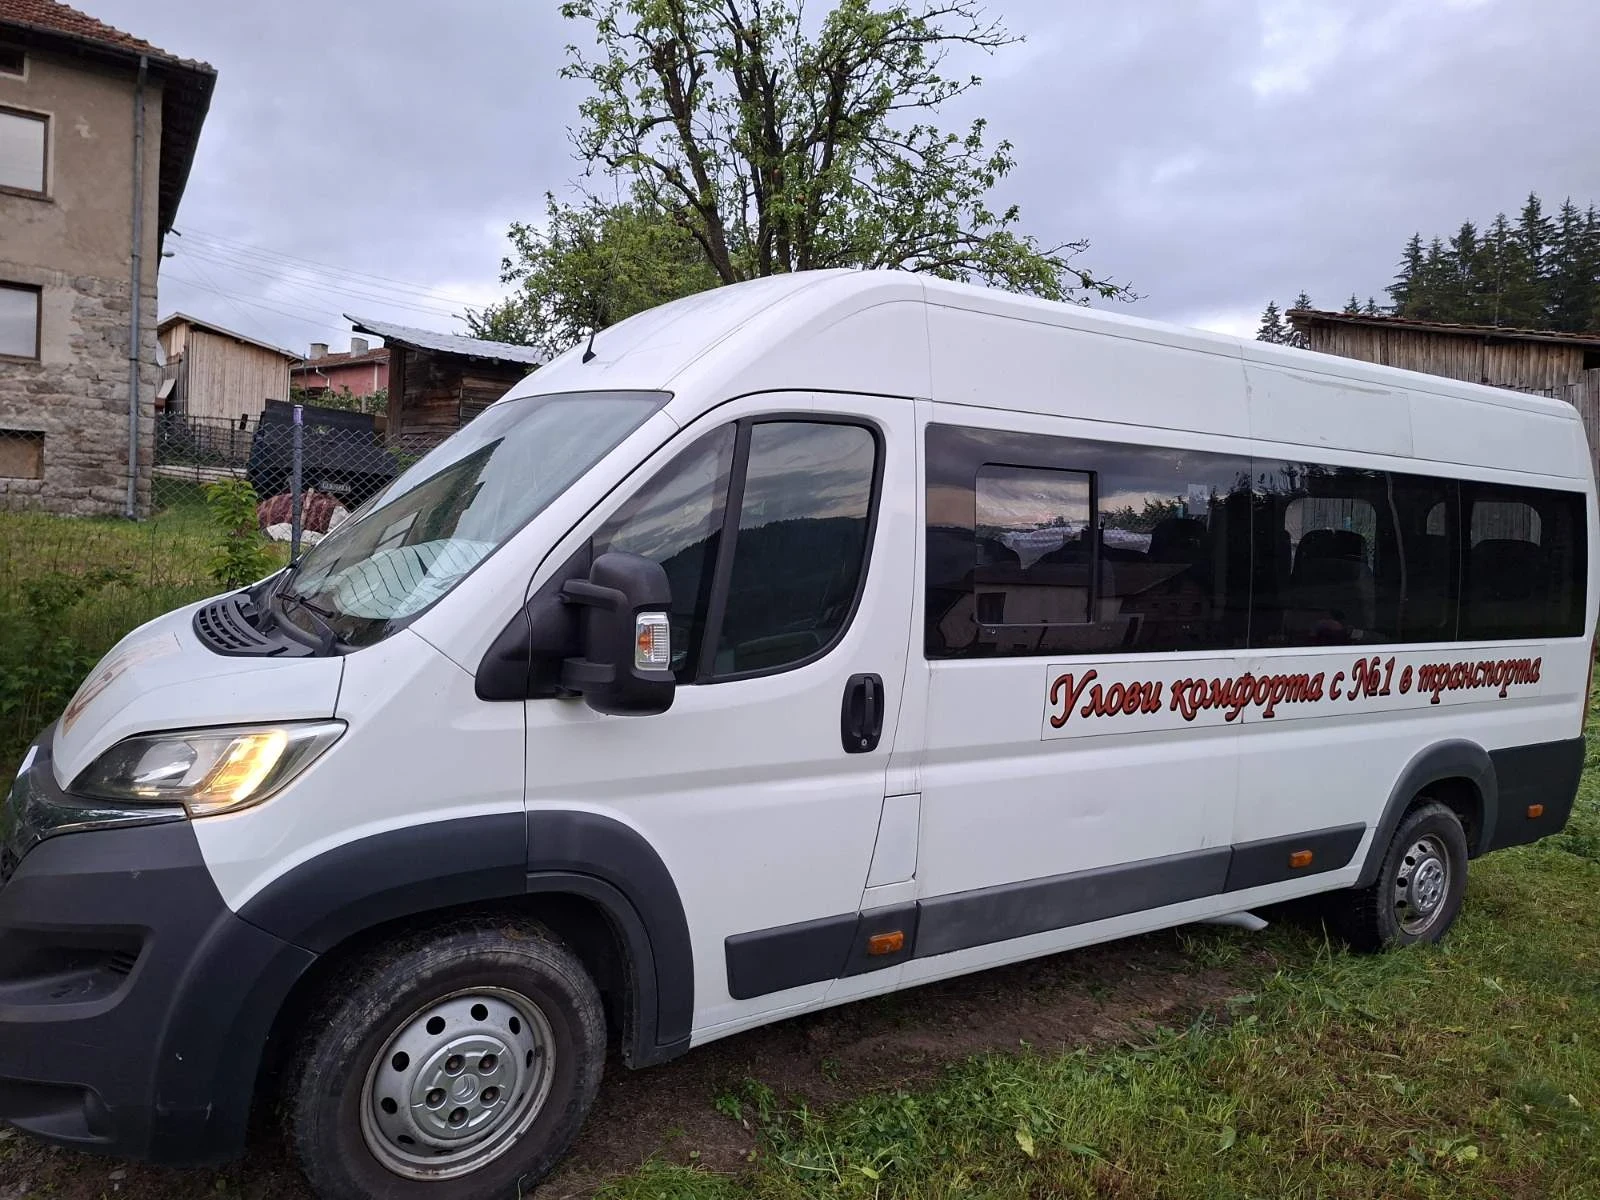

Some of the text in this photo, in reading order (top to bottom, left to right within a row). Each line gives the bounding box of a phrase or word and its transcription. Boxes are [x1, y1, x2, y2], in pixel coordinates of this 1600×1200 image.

[1050, 669, 1163, 728] Улови
[1170, 671, 1324, 721] комфорта
[1329, 671, 1345, 701] с
[1399, 665, 1413, 694] в
[1418, 656, 1542, 704] транспорта
